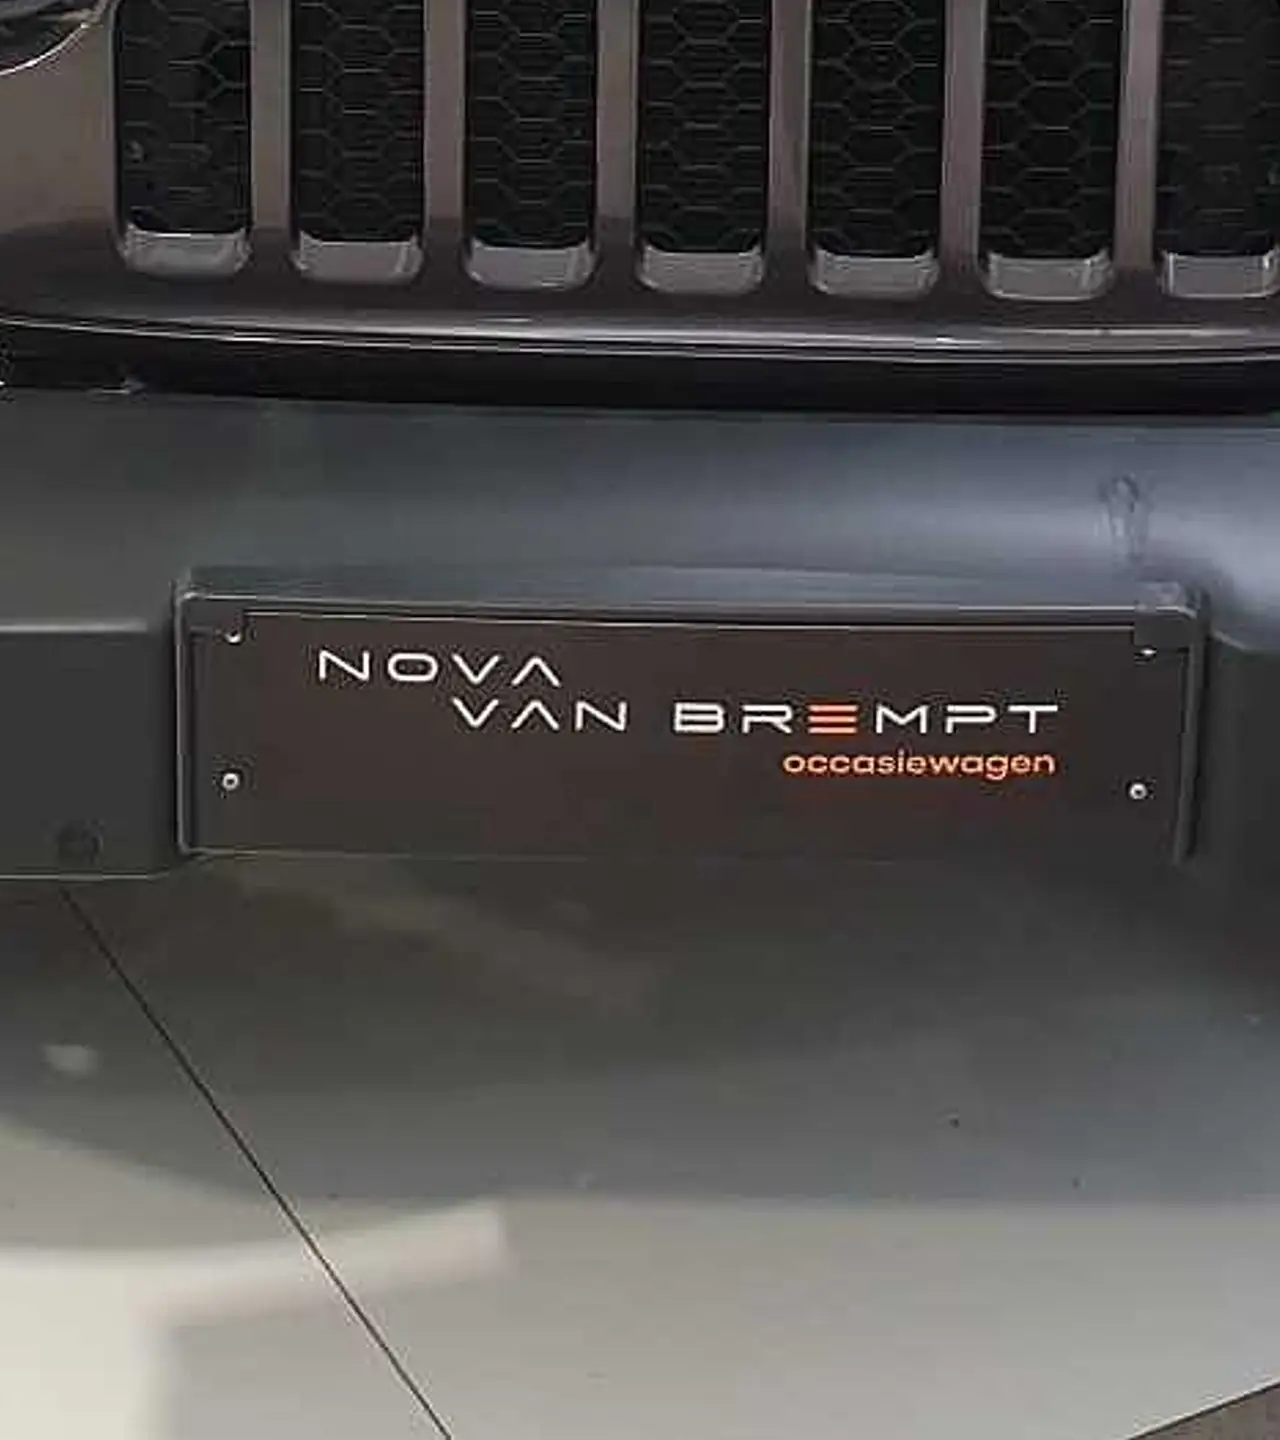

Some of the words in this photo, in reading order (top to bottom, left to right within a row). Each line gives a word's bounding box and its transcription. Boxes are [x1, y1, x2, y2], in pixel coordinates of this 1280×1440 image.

[317, 649, 562, 688] NOVA
[451, 696, 628, 732] VAN
[672, 701, 1060, 735] BREMPT
[781, 748, 1057, 782] occasiewagen
